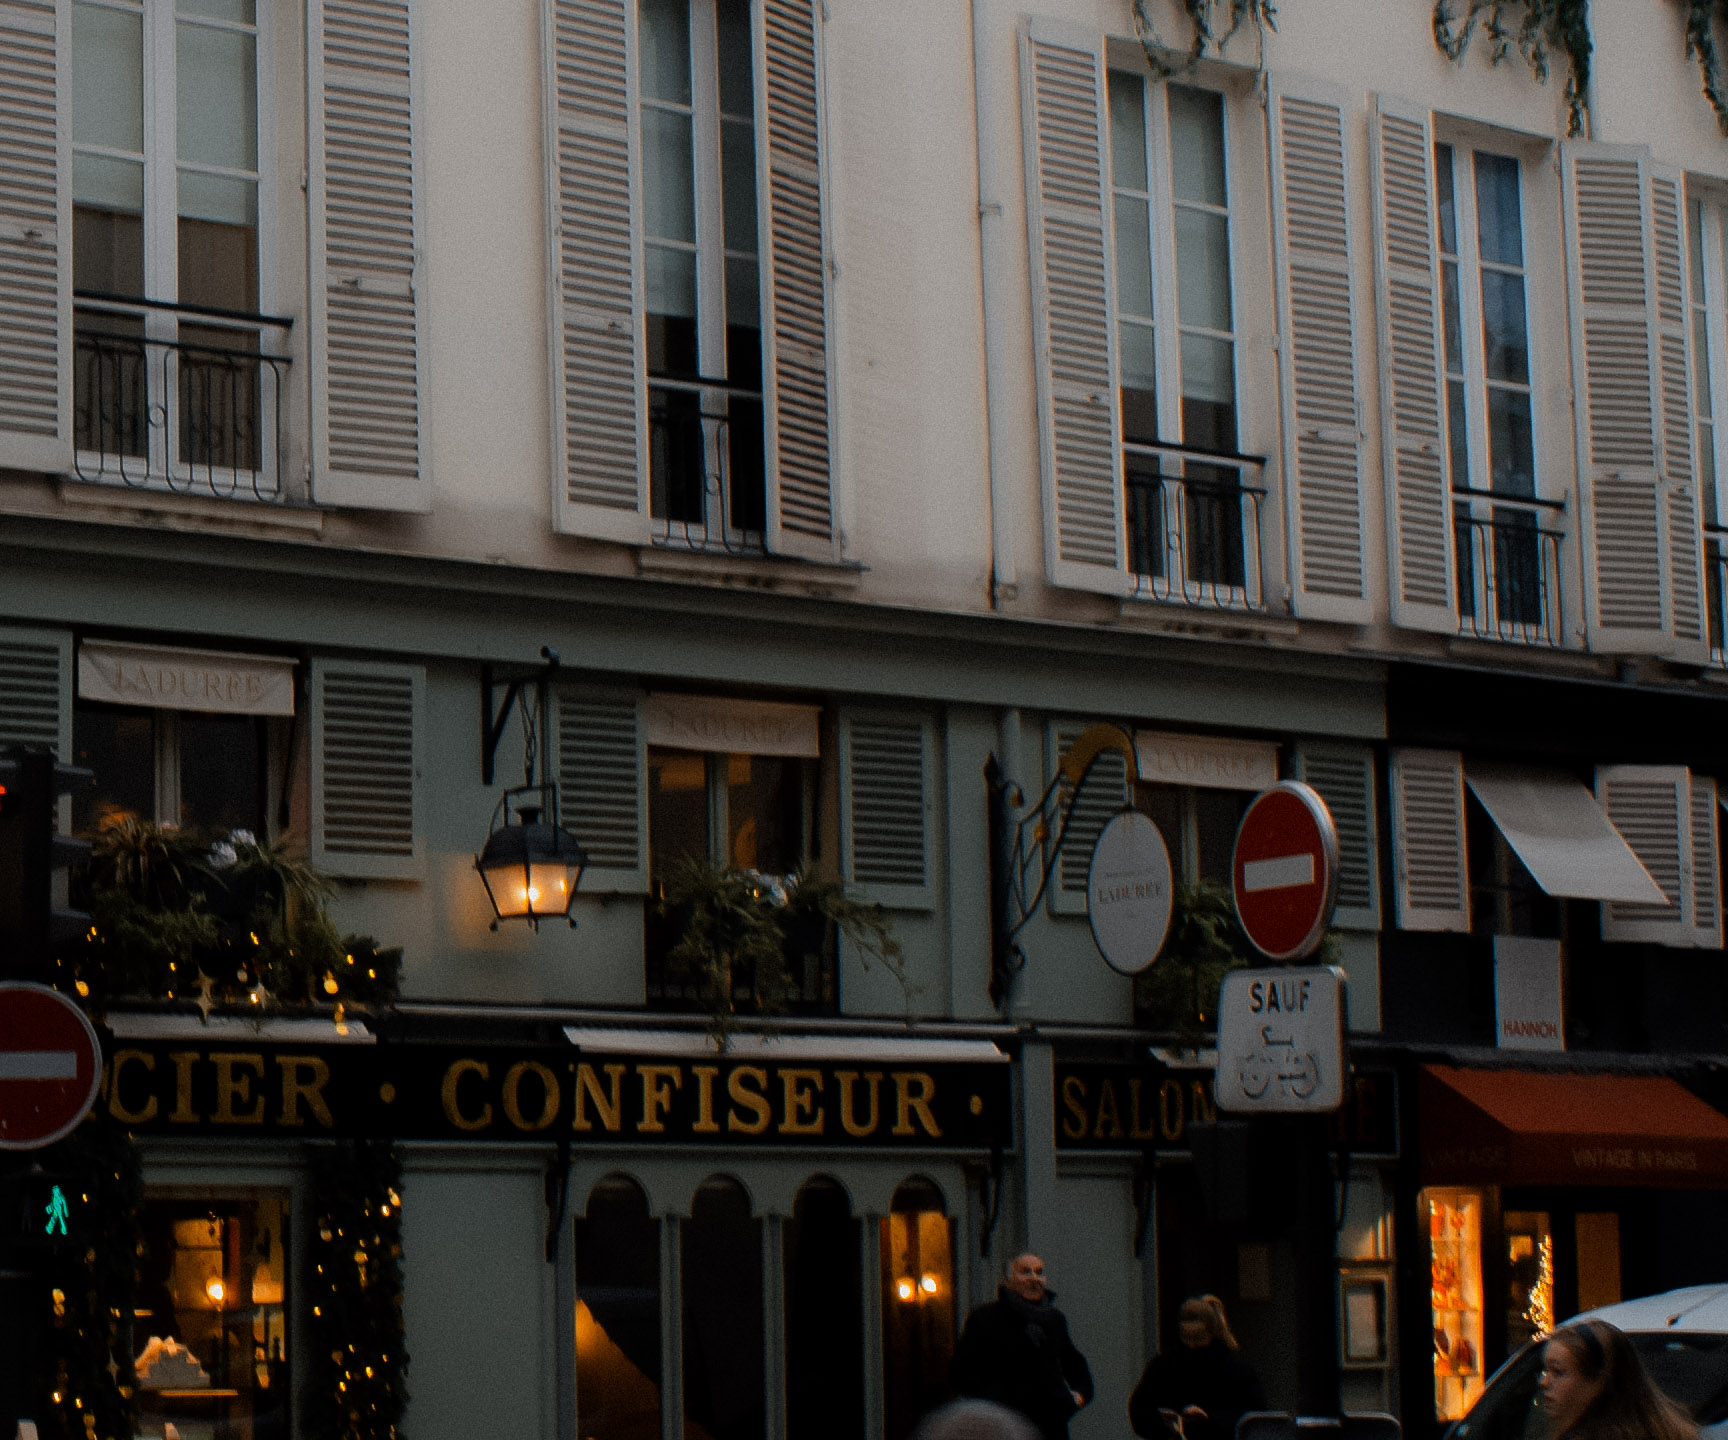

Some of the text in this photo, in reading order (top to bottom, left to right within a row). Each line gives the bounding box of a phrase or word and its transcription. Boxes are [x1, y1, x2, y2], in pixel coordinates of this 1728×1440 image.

[1249, 979, 1310, 1014] SAUF
[439, 1057, 944, 1140] CONFISEUR
[1572, 1148, 1633, 1169] VINTAGE
[1638, 1150, 1653, 1168] IN
